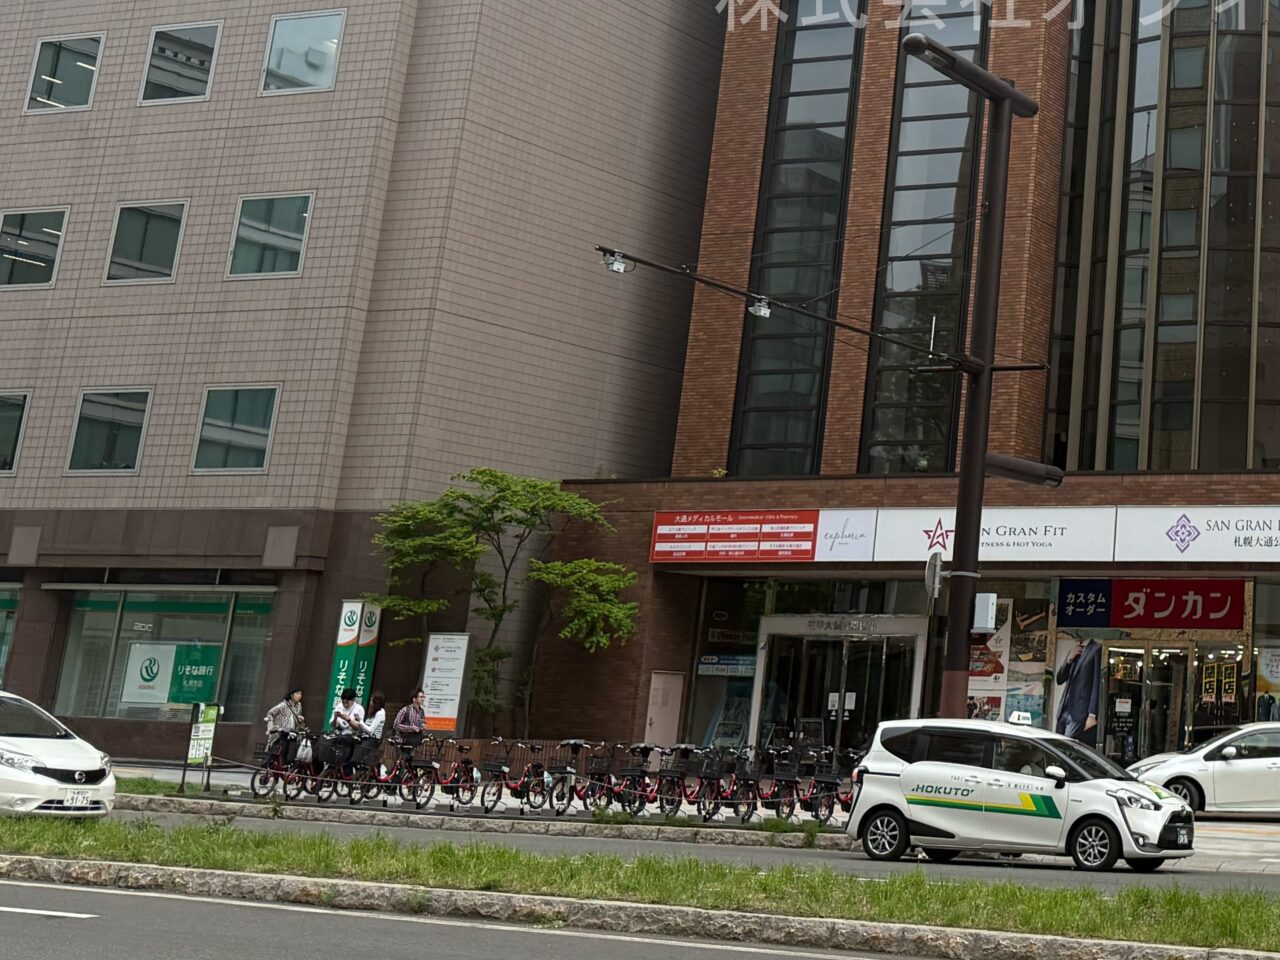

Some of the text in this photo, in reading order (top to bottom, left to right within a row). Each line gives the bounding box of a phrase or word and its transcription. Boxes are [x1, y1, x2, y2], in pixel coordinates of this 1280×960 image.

[674, 514, 734, 523] 大通メディカルモール
[995, 525, 1038, 536] GRAN
[1043, 525, 1067, 536] FIT
[1205, 519, 1231, 531] SAN
[1235, 519, 1272, 531] GRAN
[1066, 592, 1106, 604] カスタム
[1123, 587, 1232, 620] ダンカン
[1065, 604, 1106, 616] オーダー
[177, 665, 214, 676] りそな銀行
[332, 659, 349, 709] りそな銀
[354, 660, 368, 705] りそな銀
[915, 784, 971, 797] HOKUTO
